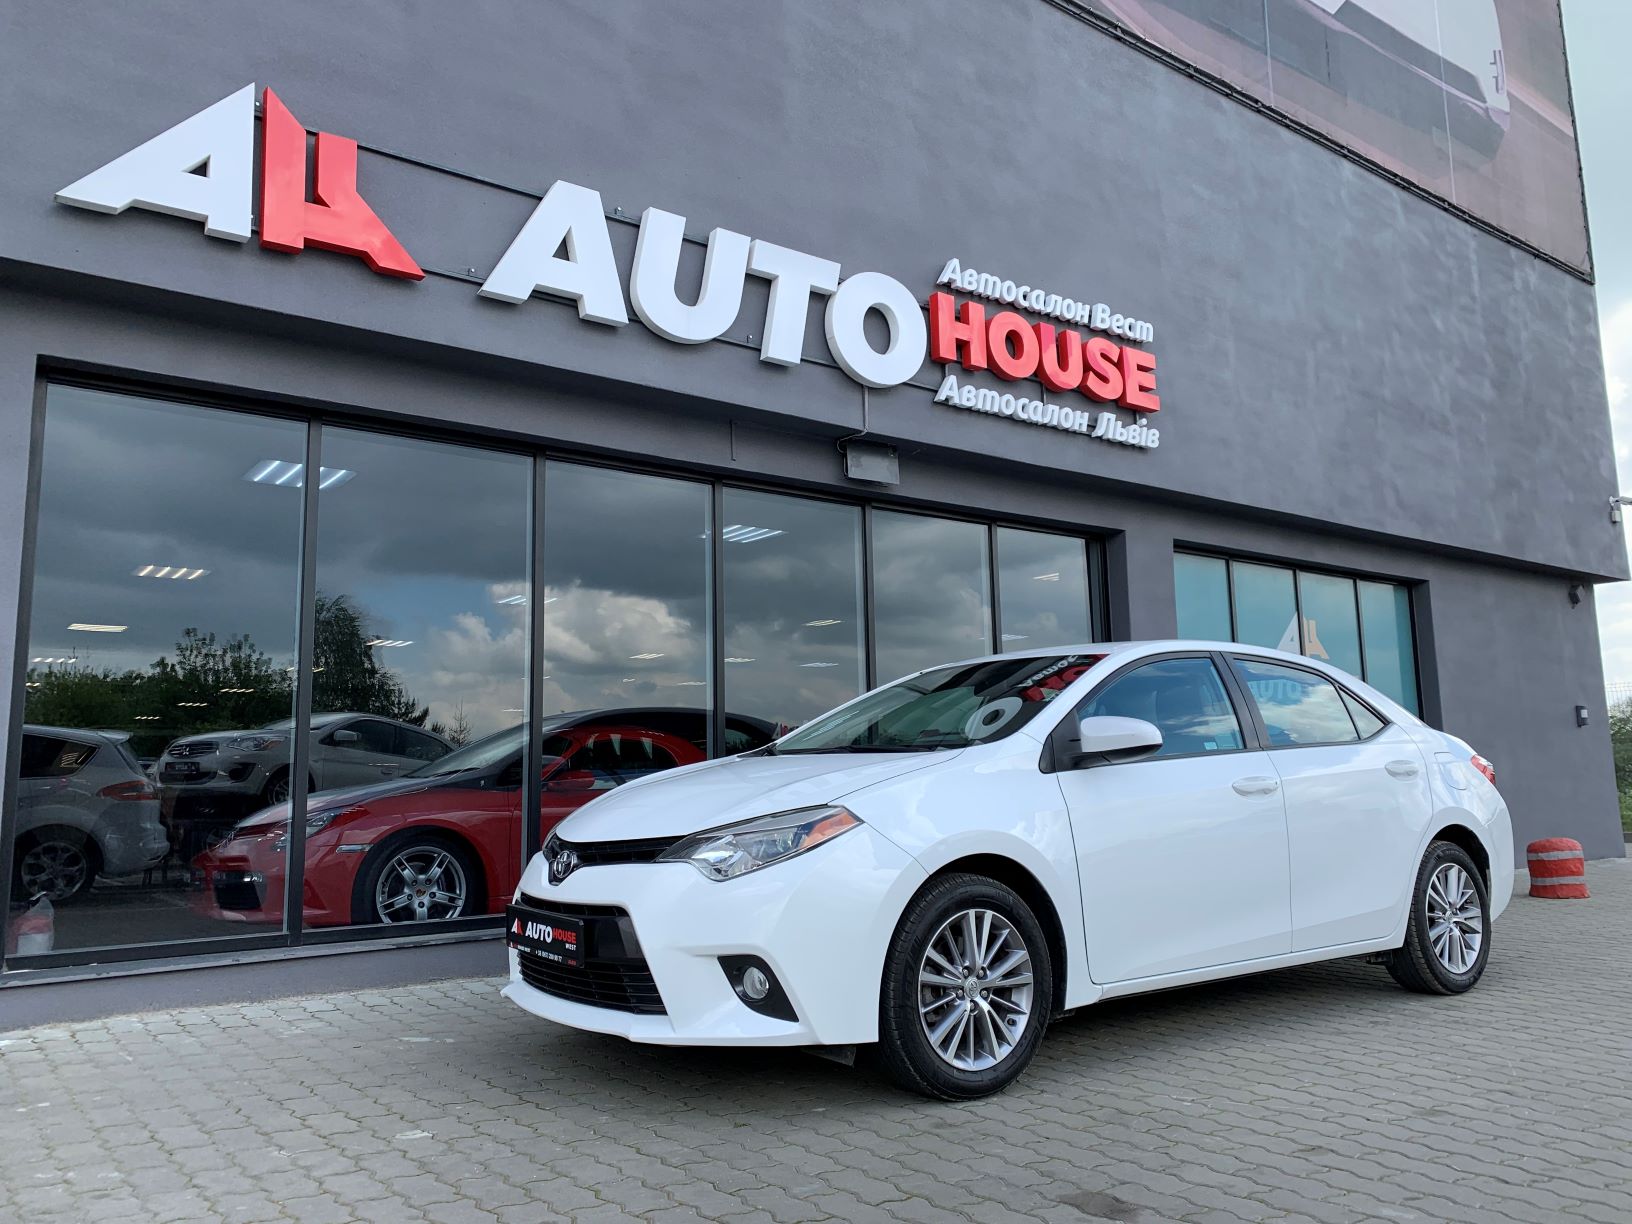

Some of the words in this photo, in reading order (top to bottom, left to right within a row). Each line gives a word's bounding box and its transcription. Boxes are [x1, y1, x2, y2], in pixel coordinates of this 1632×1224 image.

[477, 179, 928, 389] AUTO
[937, 257, 1090, 325] Автосалон
[1090, 303, 1154, 343] Вест
[929, 291, 1160, 414] HOUSE
[933, 374, 1089, 432] Автосалон
[1092, 411, 1160, 448] Львів
